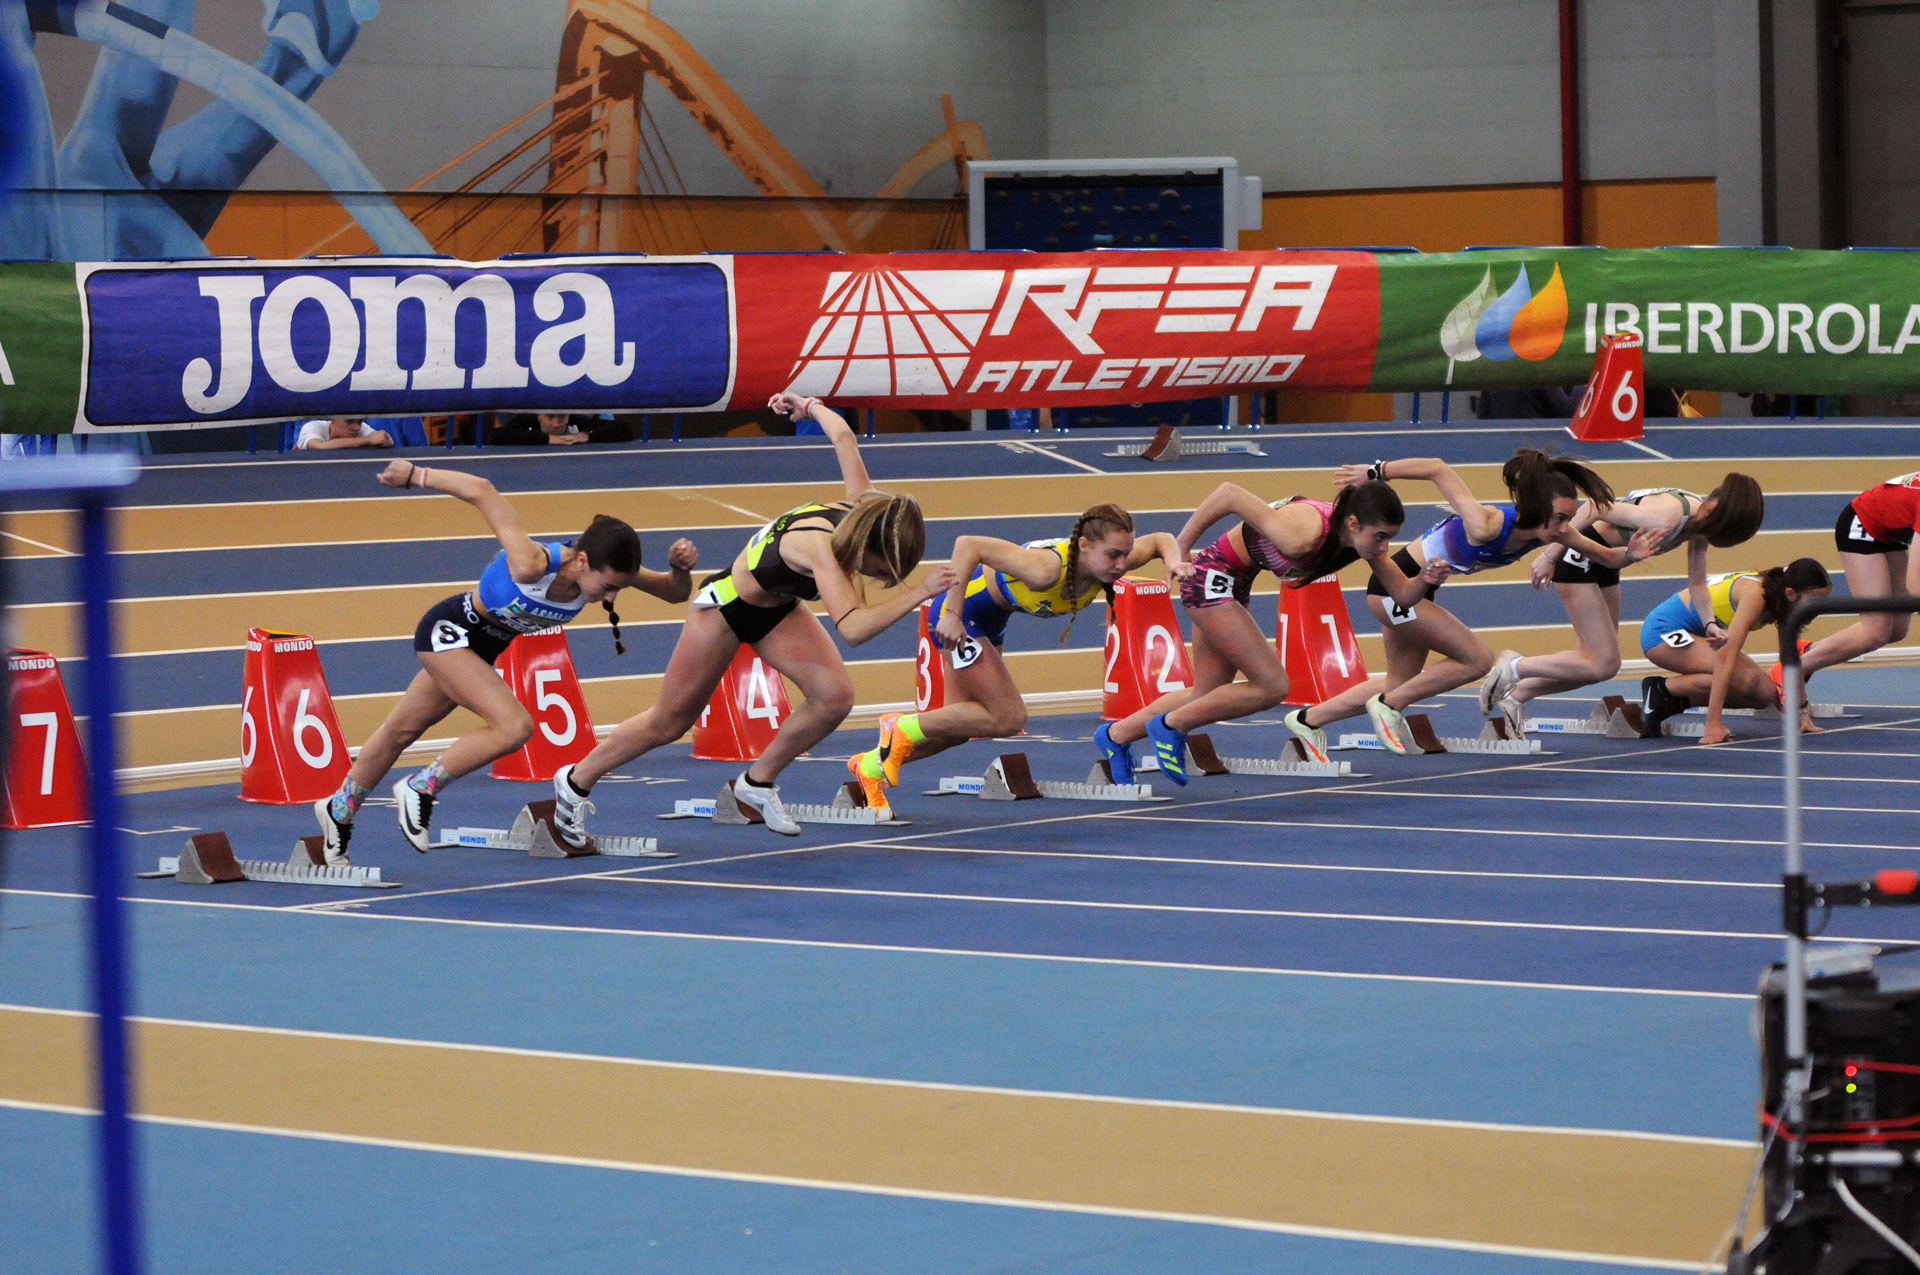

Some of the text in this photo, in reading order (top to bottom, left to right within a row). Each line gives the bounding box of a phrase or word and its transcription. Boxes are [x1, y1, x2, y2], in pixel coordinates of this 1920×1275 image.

[991, 265, 1339, 356] RFEA
[1585, 302, 1920, 354] IBERDROLA
[1614, 340, 1641, 349] MONDO
[967, 354, 1306, 396] ATLETISMO
[1579, 371, 1600, 418] 6
[1611, 370, 1639, 422] 6
[1135, 585, 1168, 595] MONDO
[1210, 574, 1229, 594] 5
[1311, 573, 1337, 583] ONDO
[274, 640, 314, 653] MONDO
[523, 624, 562, 637] ONDO
[957, 637, 977, 663] 6
[1279, 613, 1289, 668] 1
[1320, 613, 1350, 678] 1
[1667, 632, 1689, 646] 2
[8, 658, 56, 671] MONDO
[915, 636, 932, 712] 3
[1104, 623, 1121, 693] 2
[1146, 624, 1186, 693] 2
[534, 669, 577, 747] 5
[746, 657, 780, 730] 4
[241, 686, 257, 768] 6
[293, 688, 333, 769] 6
[1357, 739, 1382, 747] MOND
[1537, 723, 1565, 731] MONDO
[20, 711, 59, 796] 7
[694, 806, 719, 815] MOND
[459, 835, 488, 845] MONDO
